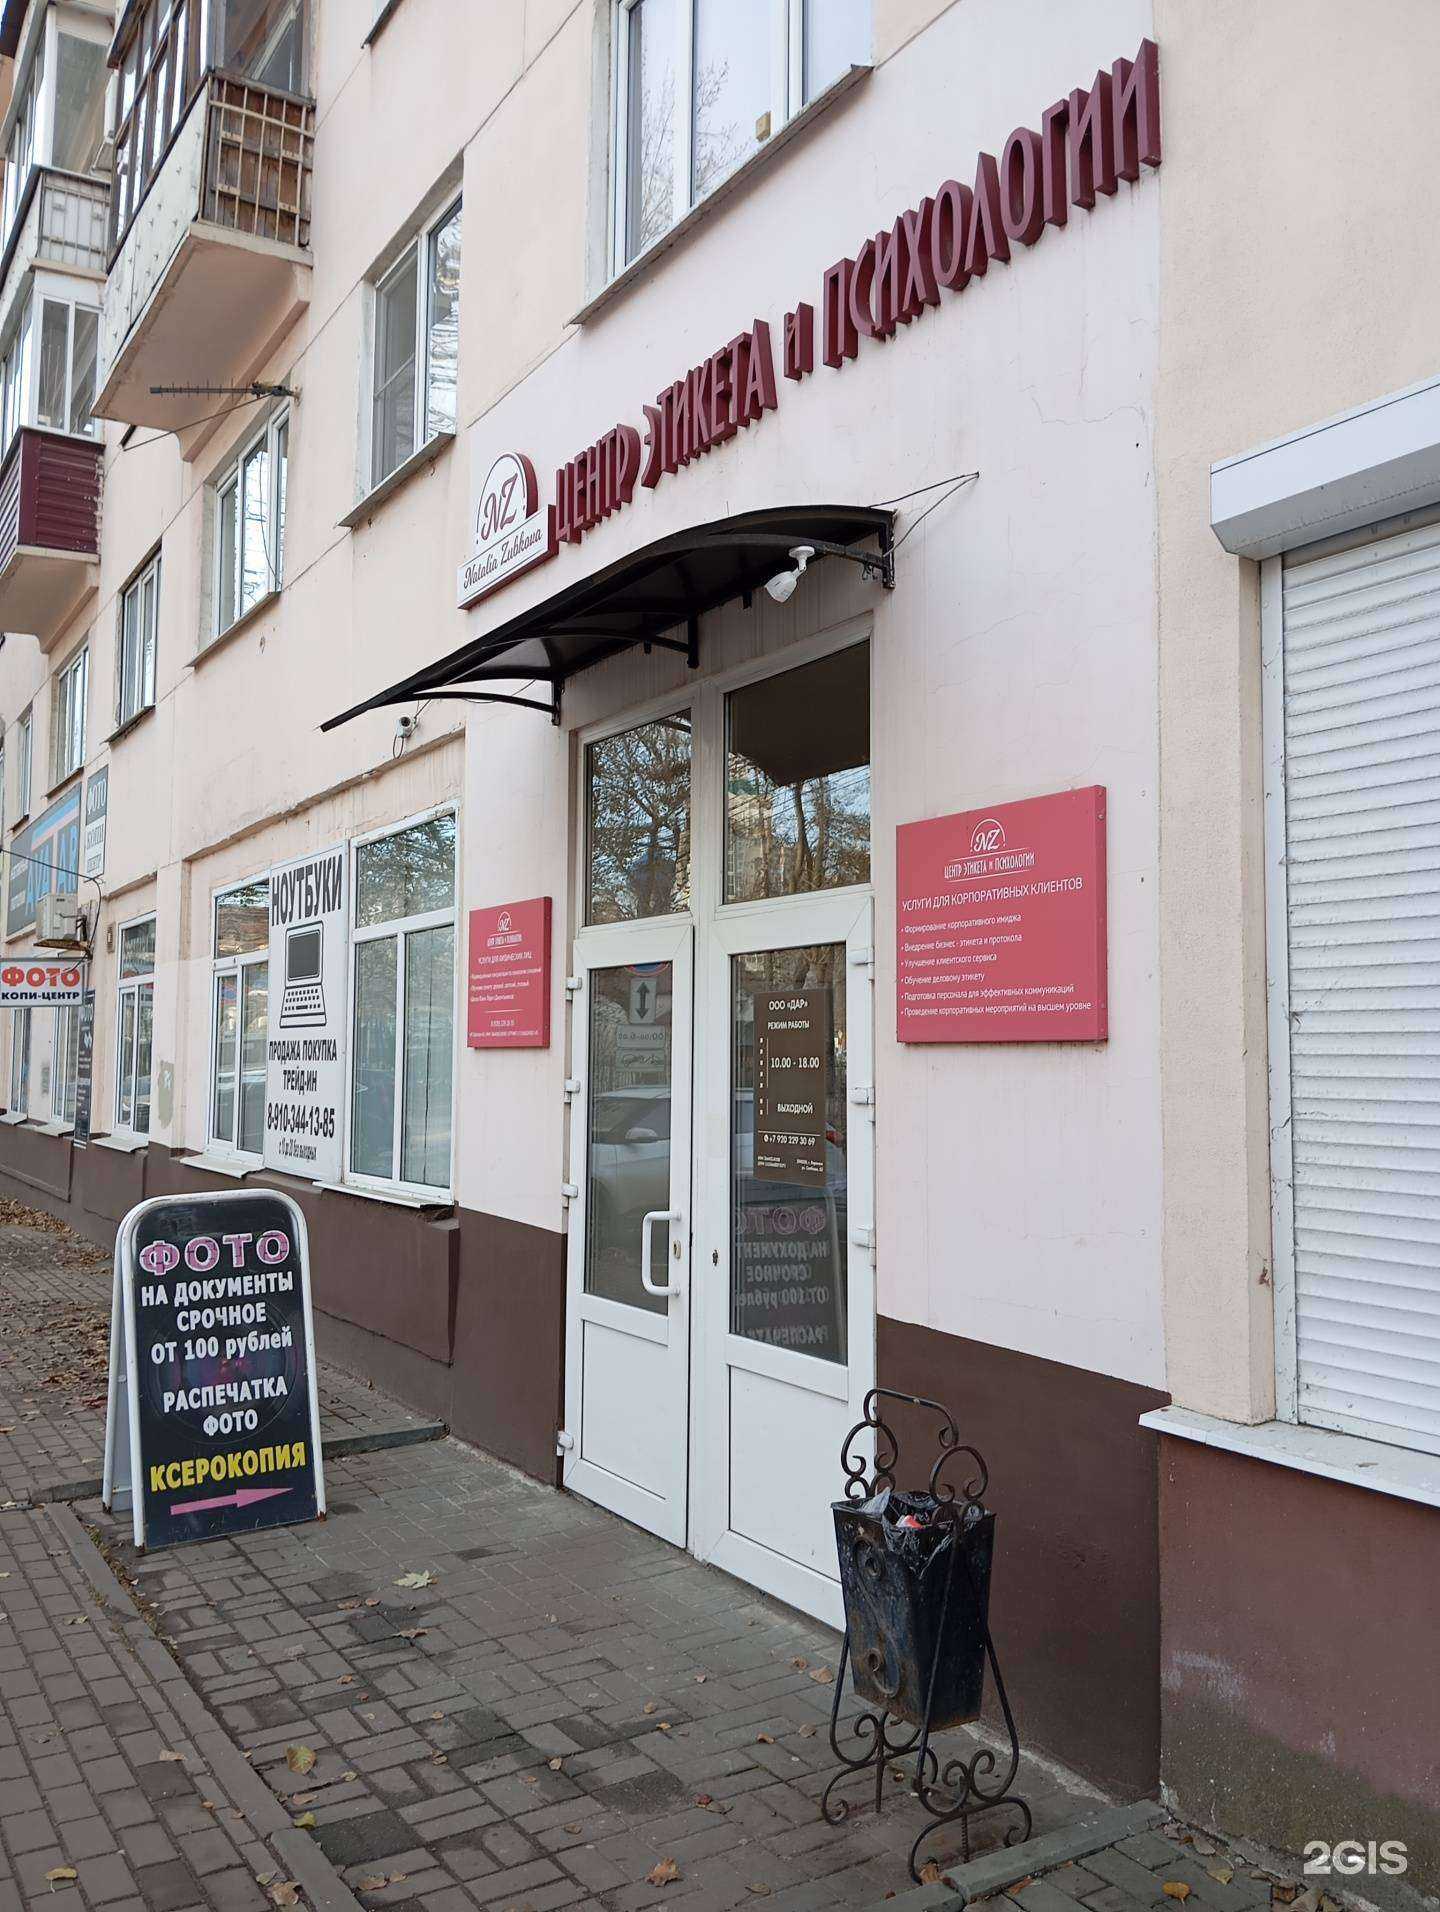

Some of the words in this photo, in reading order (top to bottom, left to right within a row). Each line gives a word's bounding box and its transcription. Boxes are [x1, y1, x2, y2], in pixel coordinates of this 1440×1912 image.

[555, 423, 642, 544] ЦЕНТР
[641, 318, 779, 489] ЭТИКЕТА
[823, 37, 1162, 369] ПСИХОЛОГИИ
[480, 473, 519, 541] NZ
[463, 554, 498, 589] Natalia
[501, 527, 543, 567] Zubkova
[974, 828, 1001, 852] NZ
[944, 863, 961, 879] ЦЕНТР
[962, 860, 987, 877] ЭТИКЕТА
[995, 852, 1035, 871] ПСИХОЛОГИИ
[271, 854, 343, 926] НОУТБУКИ
[902, 897, 932, 911] УСЛУГИ
[933, 895, 950, 910] ДЛЯ
[951, 884, 1029, 905] КОРПОРАТИВНЫХ
[1030, 877, 1083, 895] КЛИЕНТОВ
[948, 917, 996, 930] корпоративного
[989, 933, 1023, 946] протокола
[1, 966, 81, 987] ФОТО
[1024, 983, 1074, 996] коммуникаций
[1, 991, 80, 1001] КОПИ-ЦЕНТР
[768, 1000, 786, 1011] ООО
[1065, 1002, 1092, 1012] уровне
[767, 1021, 787, 1031] РЕЖИМ
[788, 1020, 810, 1030] РАБОТЫ
[268, 1040, 301, 1064] ПРОДАЖА
[302, 1039, 338, 1061] ПОКУПКА
[771, 1057, 792, 1069] 10.00
[798, 1057, 821, 1069] 18.00
[282, 1066, 318, 1095] ТРЕЙД-ИН
[267, 1102, 335, 1138] 8-910-344-13-85
[776, 1102, 814, 1115] ВЫХОДНОЙ
[138, 1229, 291, 1276] ФОТО
[141, 1285, 169, 1307] НА
[173, 1270, 294, 1307] ДОКУМЕНТЫ
[176, 1302, 267, 1332] СРОЧНОЕ
[150, 1343, 178, 1365] ОТ
[184, 1337, 219, 1361] 100
[226, 1326, 293, 1360] рублей
[163, 1375, 288, 1413] РАСПЕЧАТКА
[202, 1408, 259, 1437] ФОТО
[149, 1441, 307, 1493] КСЕРОКОПИЯ
